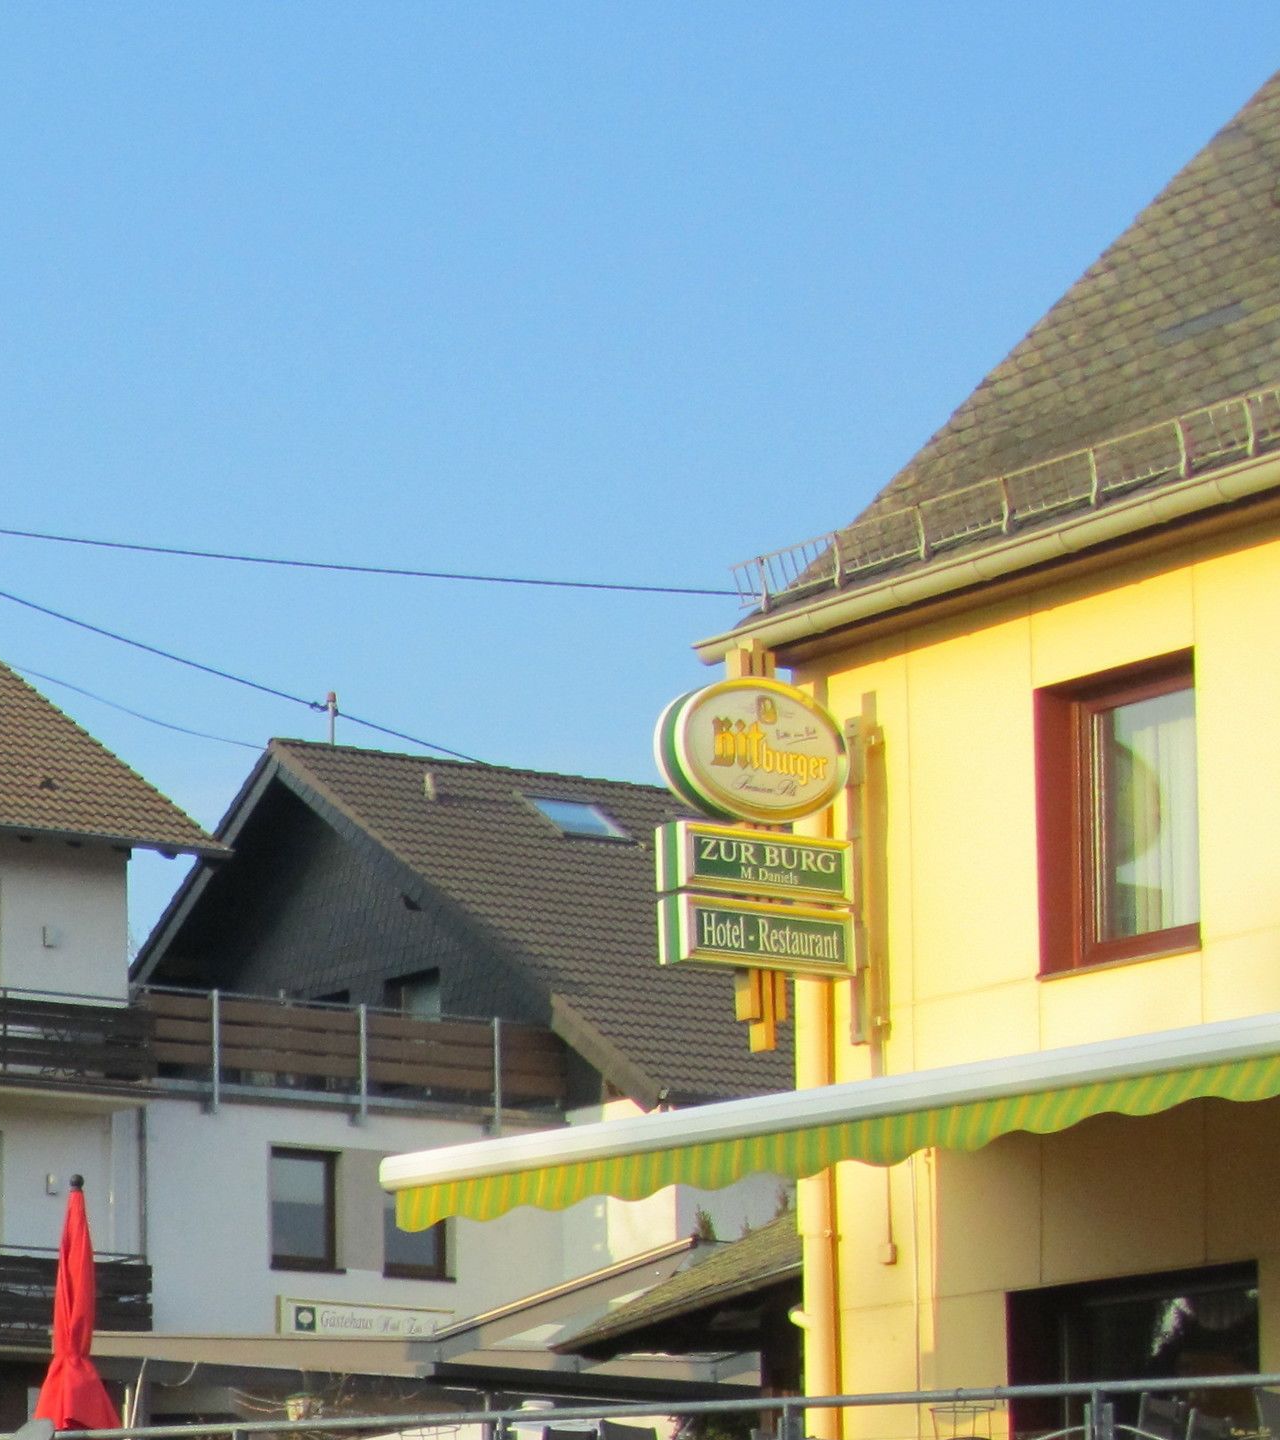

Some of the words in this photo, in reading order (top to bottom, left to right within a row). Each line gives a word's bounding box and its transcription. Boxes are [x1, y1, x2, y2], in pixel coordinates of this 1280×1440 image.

[710, 716, 829, 786] Bitburger
[700, 838, 758, 865] ZUR
[763, 845, 837, 874] BURG
[740, 866, 756, 881] M.
[758, 867, 800, 886] Daniels
[702, 912, 745, 949] Hotel
[757, 918, 840, 960] Restaurant
[320, 1310, 373, 1329] Gästehaus
